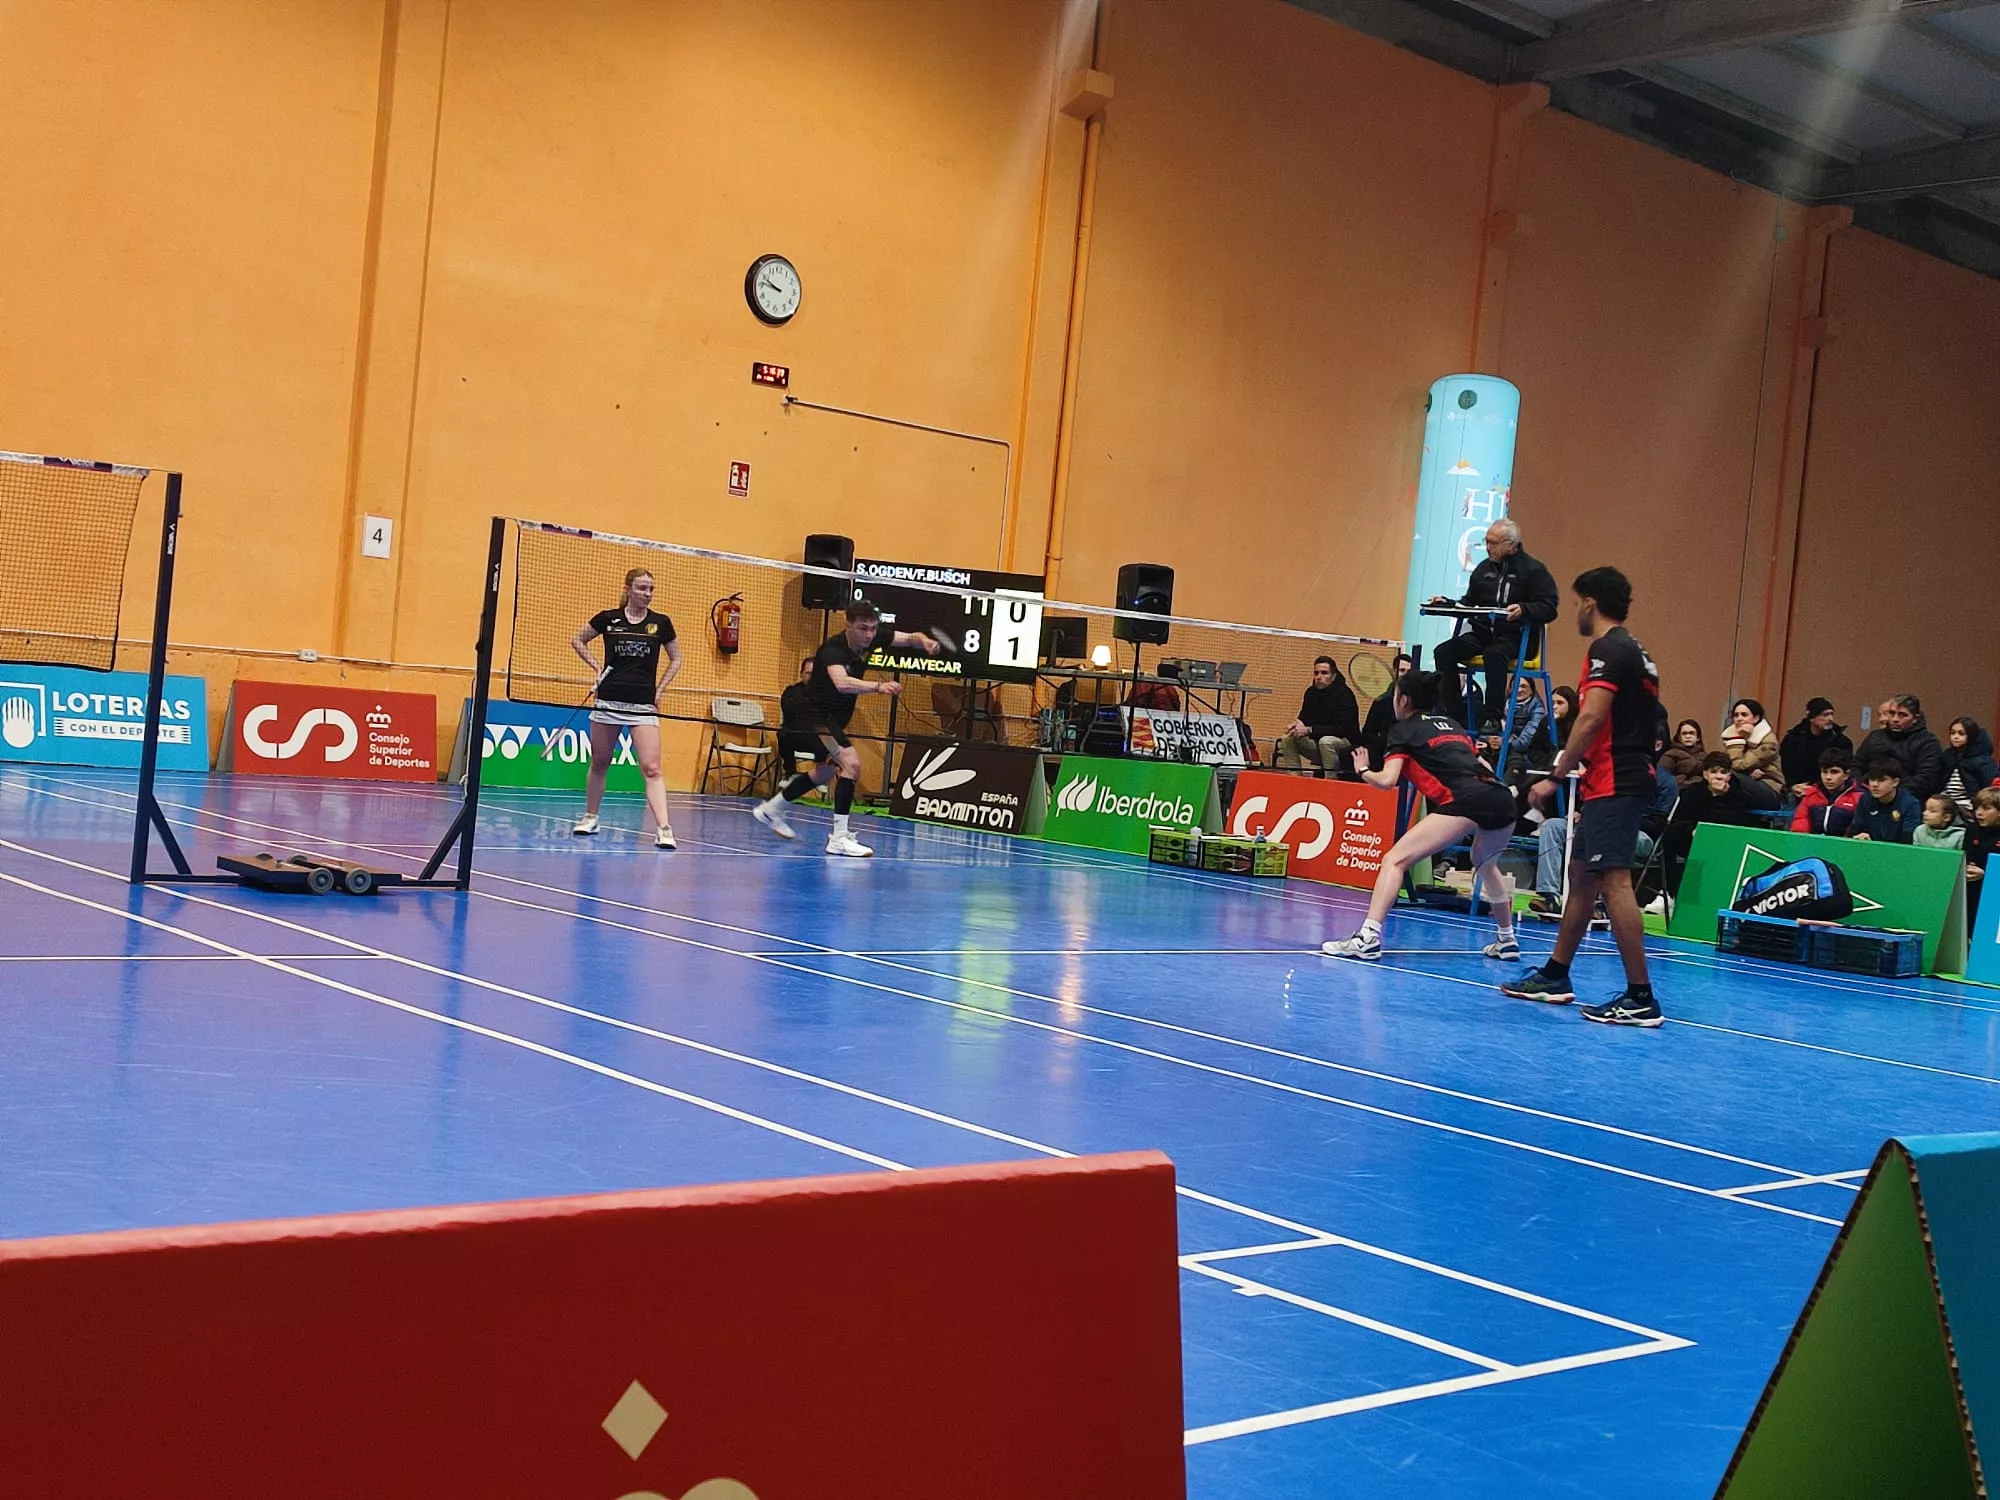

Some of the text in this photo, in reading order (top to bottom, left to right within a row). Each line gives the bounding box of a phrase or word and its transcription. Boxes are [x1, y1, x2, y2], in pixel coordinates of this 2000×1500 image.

[372, 527, 384, 544] 4
[854, 588, 863, 600] 0
[961, 595, 990, 617] 11
[1009, 602, 1027, 624] 0
[963, 629, 981, 653] 8
[1008, 636, 1020, 661] 1
[52, 690, 191, 720] LOTERAS
[70, 723, 176, 739] CON EL DEPTE
[369, 732, 410, 748] Consejo
[369, 744, 413, 758] Superior
[538, 726, 638, 767] YONX
[1181, 737, 1239, 758] AGÓN
[369, 756, 431, 769] de Deportes
[980, 792, 1019, 806] ESPAÑA
[1096, 785, 1194, 825] Iberdrola
[915, 796, 1014, 829] BADMINTON
[1342, 829, 1382, 851] Consejo
[1339, 842, 1383, 860] Superior
[1336, 855, 1382, 872] de Depor
[1752, 883, 1811, 915] VICTOR
